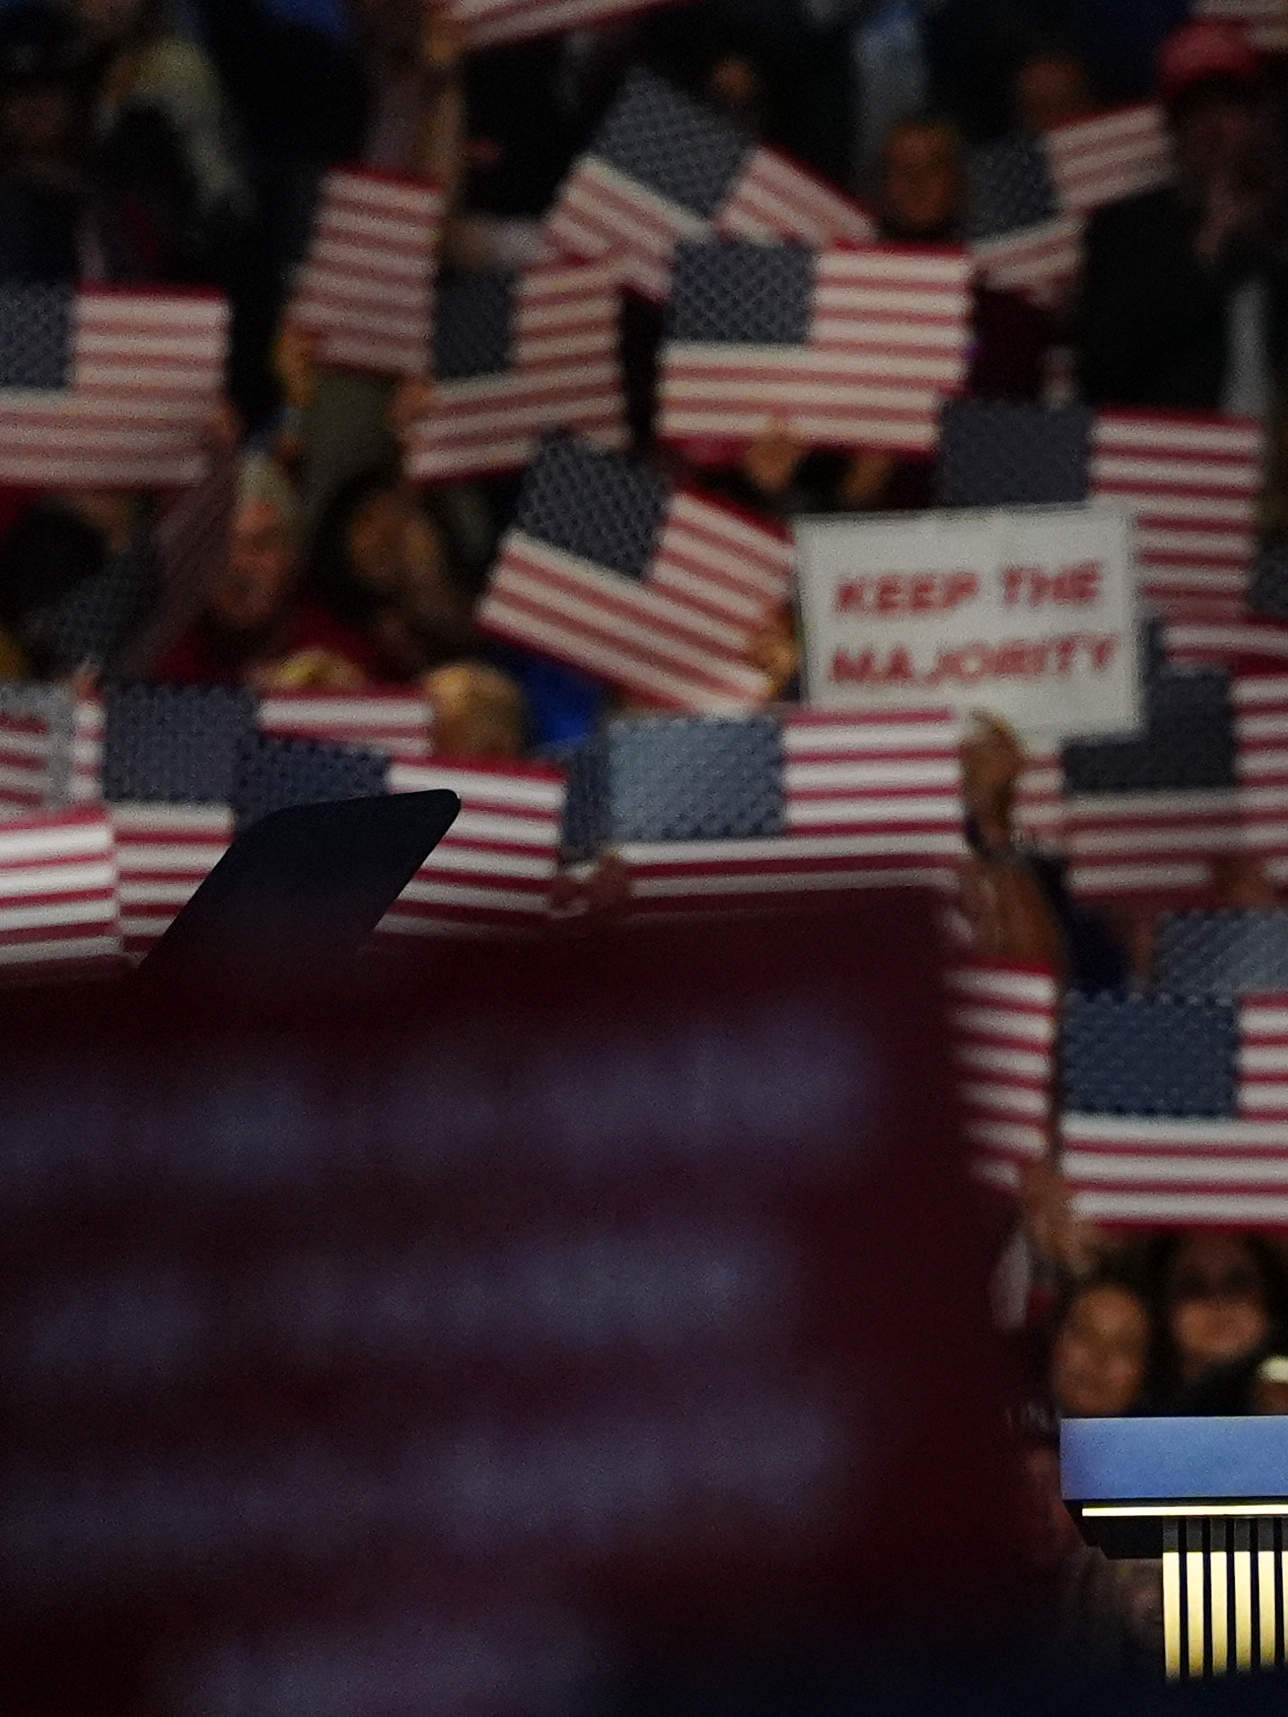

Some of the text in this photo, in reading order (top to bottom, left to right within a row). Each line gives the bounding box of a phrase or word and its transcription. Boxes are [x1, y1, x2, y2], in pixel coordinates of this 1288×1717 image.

[834, 561, 1100, 614] KEEP THE
[829, 634, 1118, 684] MAJORITY
